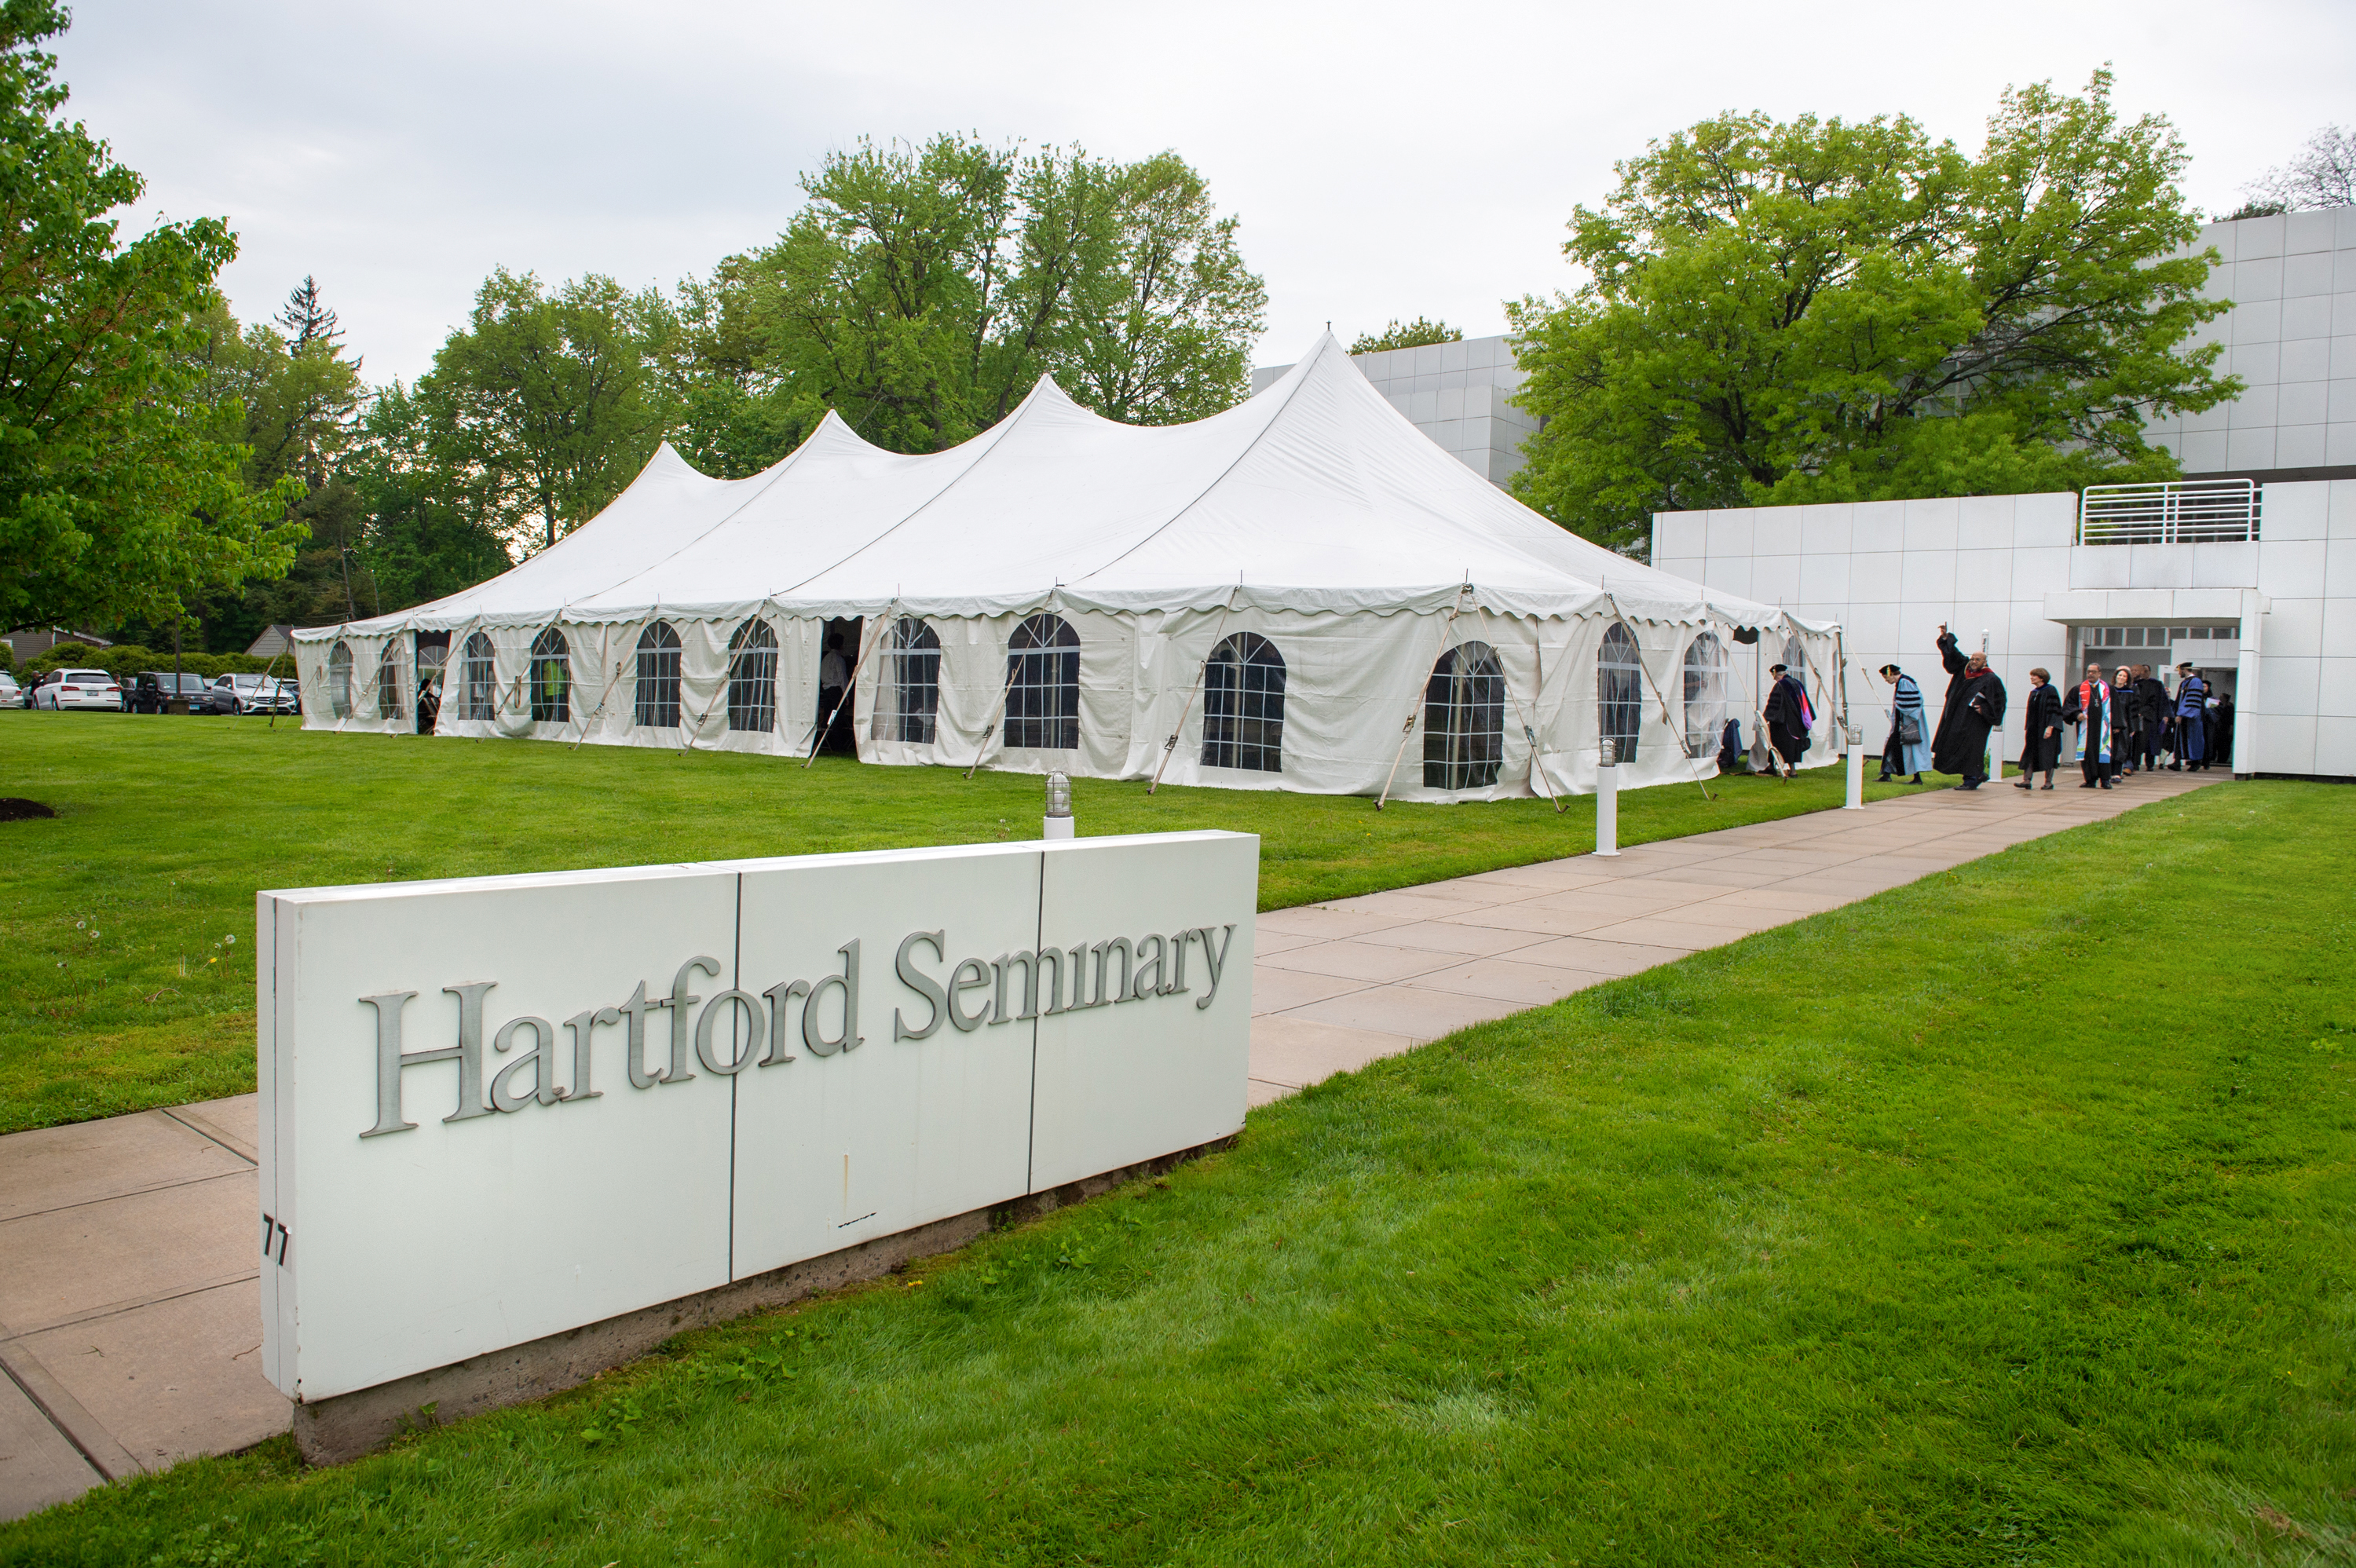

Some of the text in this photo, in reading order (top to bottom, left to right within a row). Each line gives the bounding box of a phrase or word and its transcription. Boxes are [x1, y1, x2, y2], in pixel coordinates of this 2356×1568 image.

[358, 923, 1238, 1138] Hartford Seminary
[263, 1212, 289, 1266] 77
